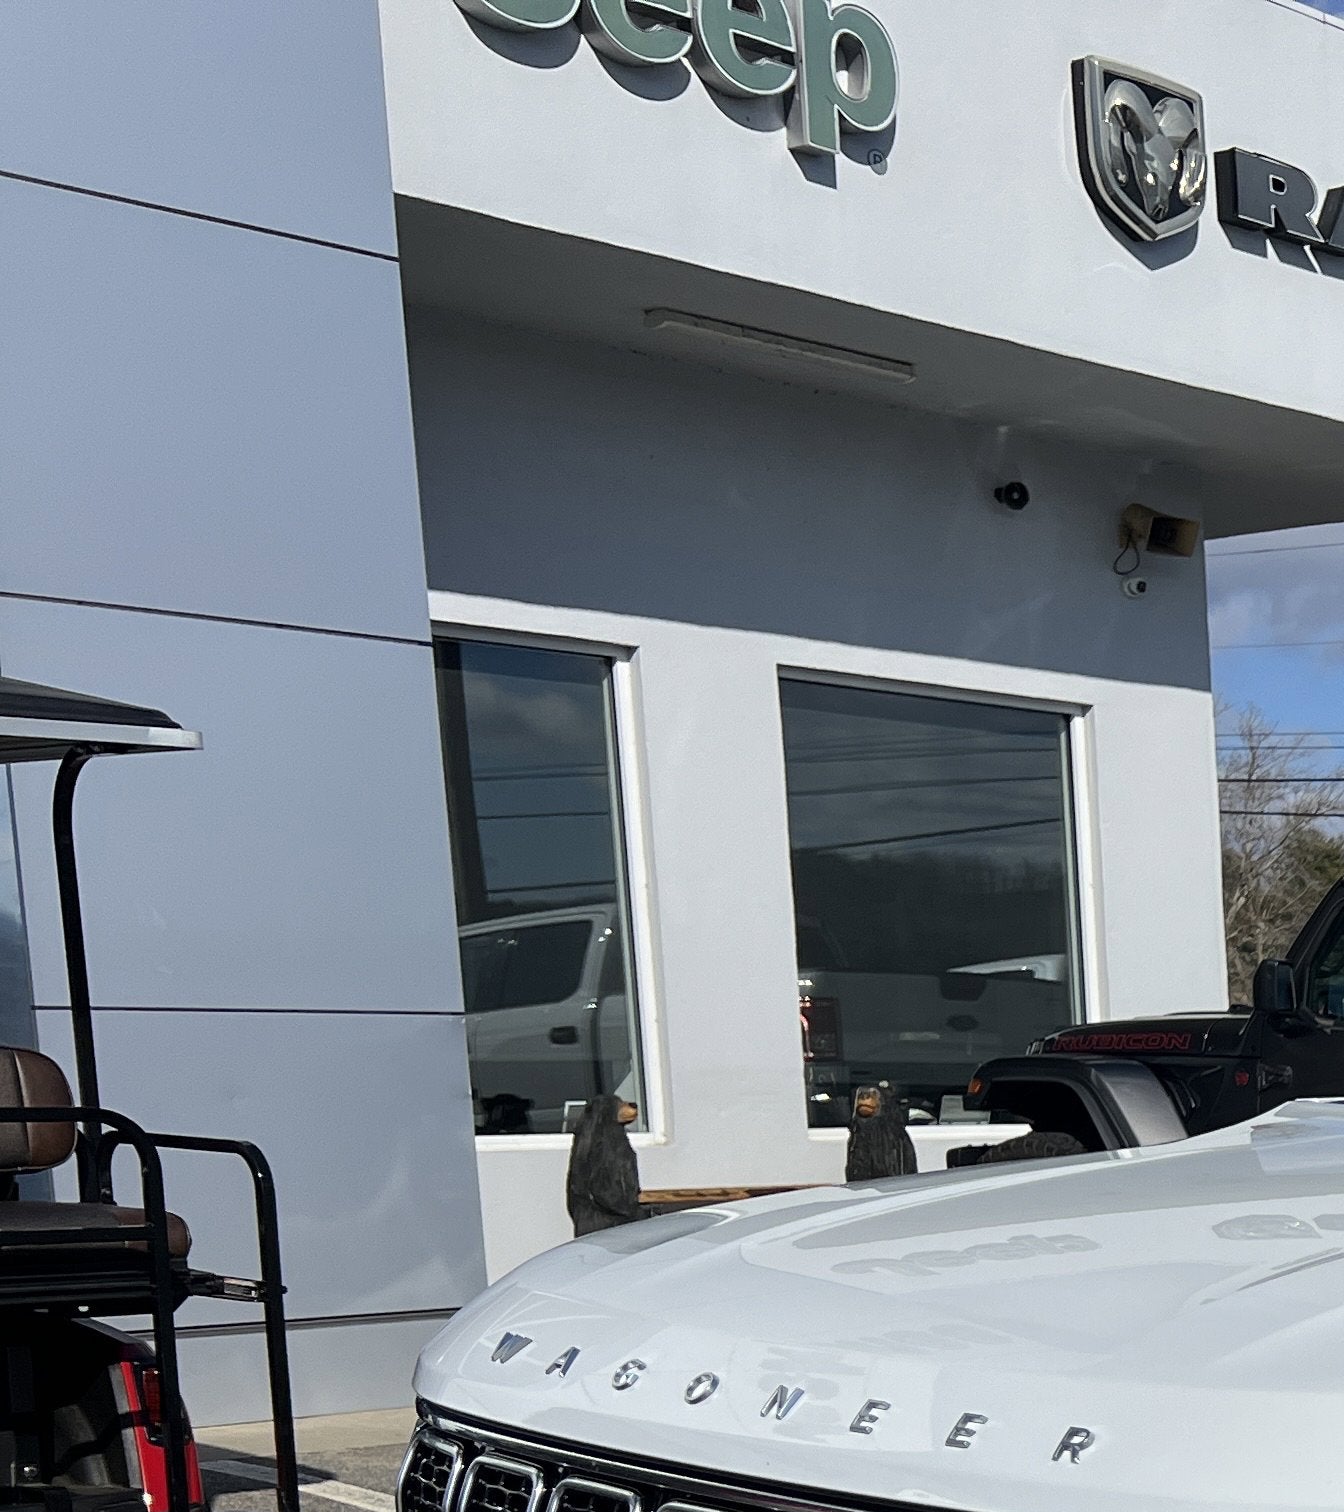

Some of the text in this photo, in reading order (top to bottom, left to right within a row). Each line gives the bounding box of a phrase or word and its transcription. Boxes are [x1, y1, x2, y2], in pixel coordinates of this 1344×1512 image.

[453, 0, 898, 154] eep
[1052, 1032, 1192, 1051] RUBICON
[490, 1331, 1096, 1465] WAGONEER
